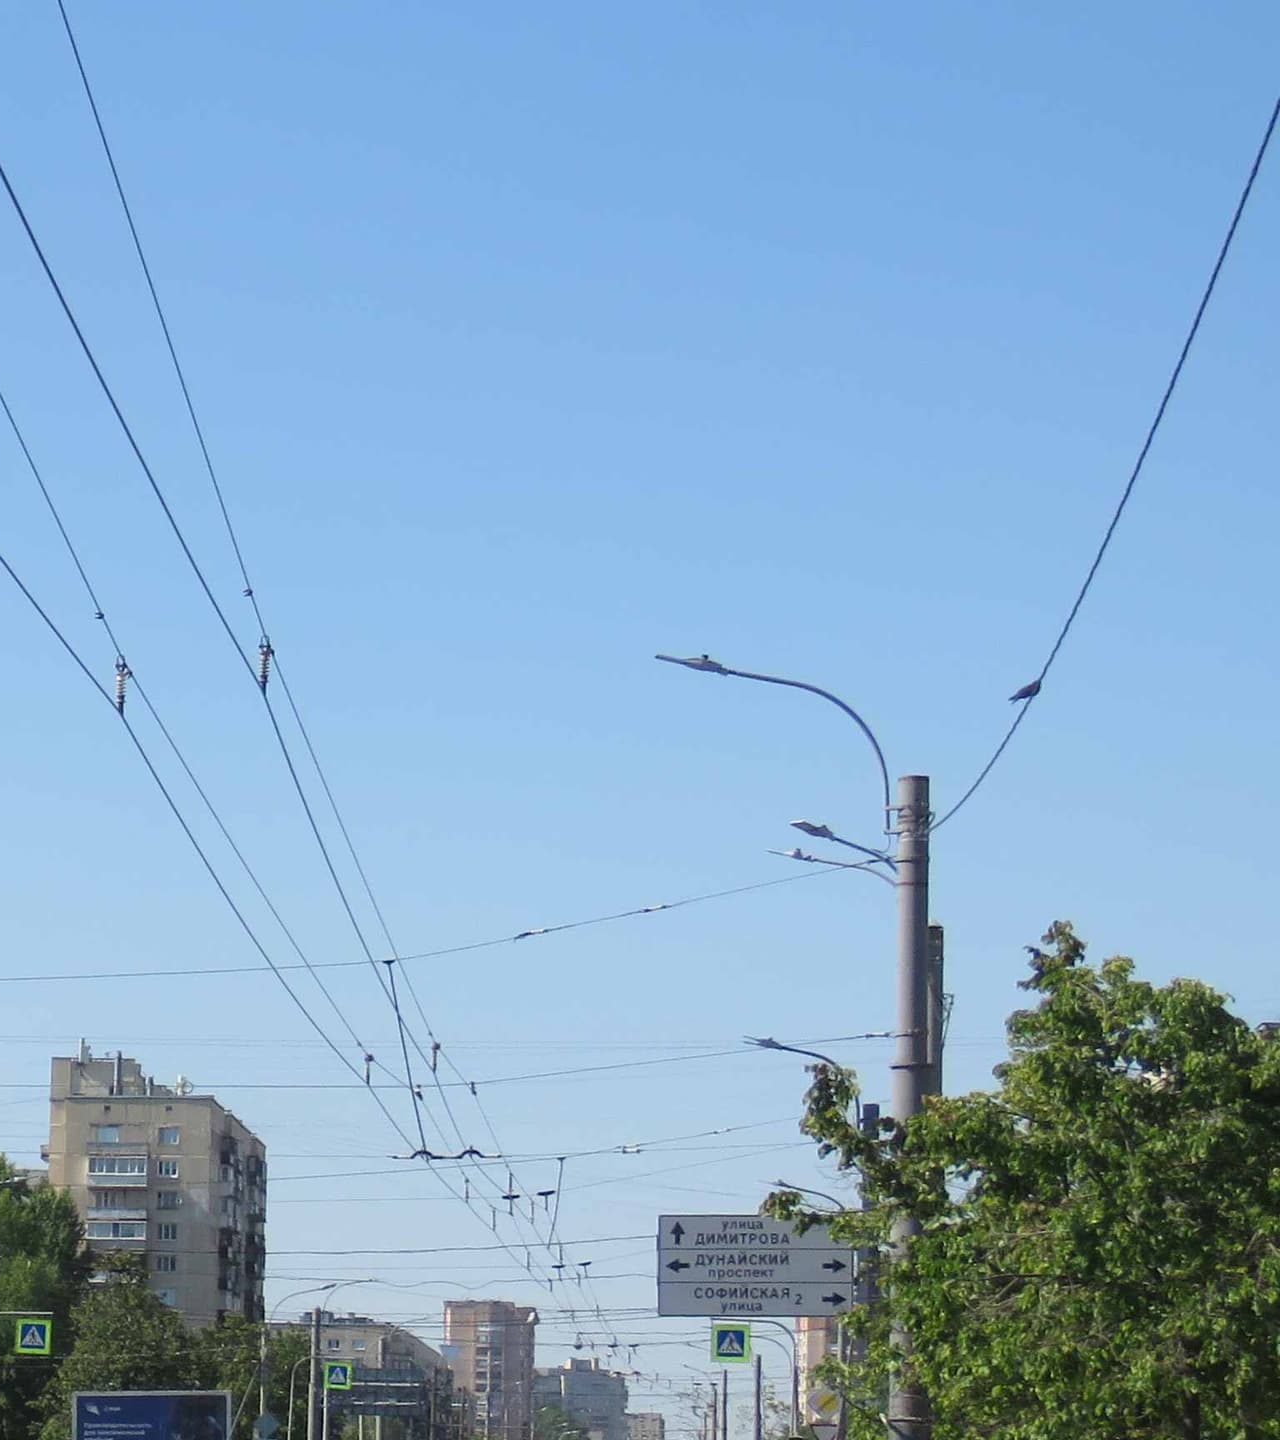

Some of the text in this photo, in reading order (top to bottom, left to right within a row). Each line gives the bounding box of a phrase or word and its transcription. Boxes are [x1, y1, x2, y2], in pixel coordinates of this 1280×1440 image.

[722, 1220, 764, 1232] улица
[695, 1233, 790, 1246] ДИМИТРОВА
[695, 1253, 790, 1267] ДУНАЙСКИЙ
[708, 1269, 774, 1280] проспект
[694, 1287, 803, 1305] СОФИЙСКАЯ 2
[721, 1301, 763, 1313] улица
